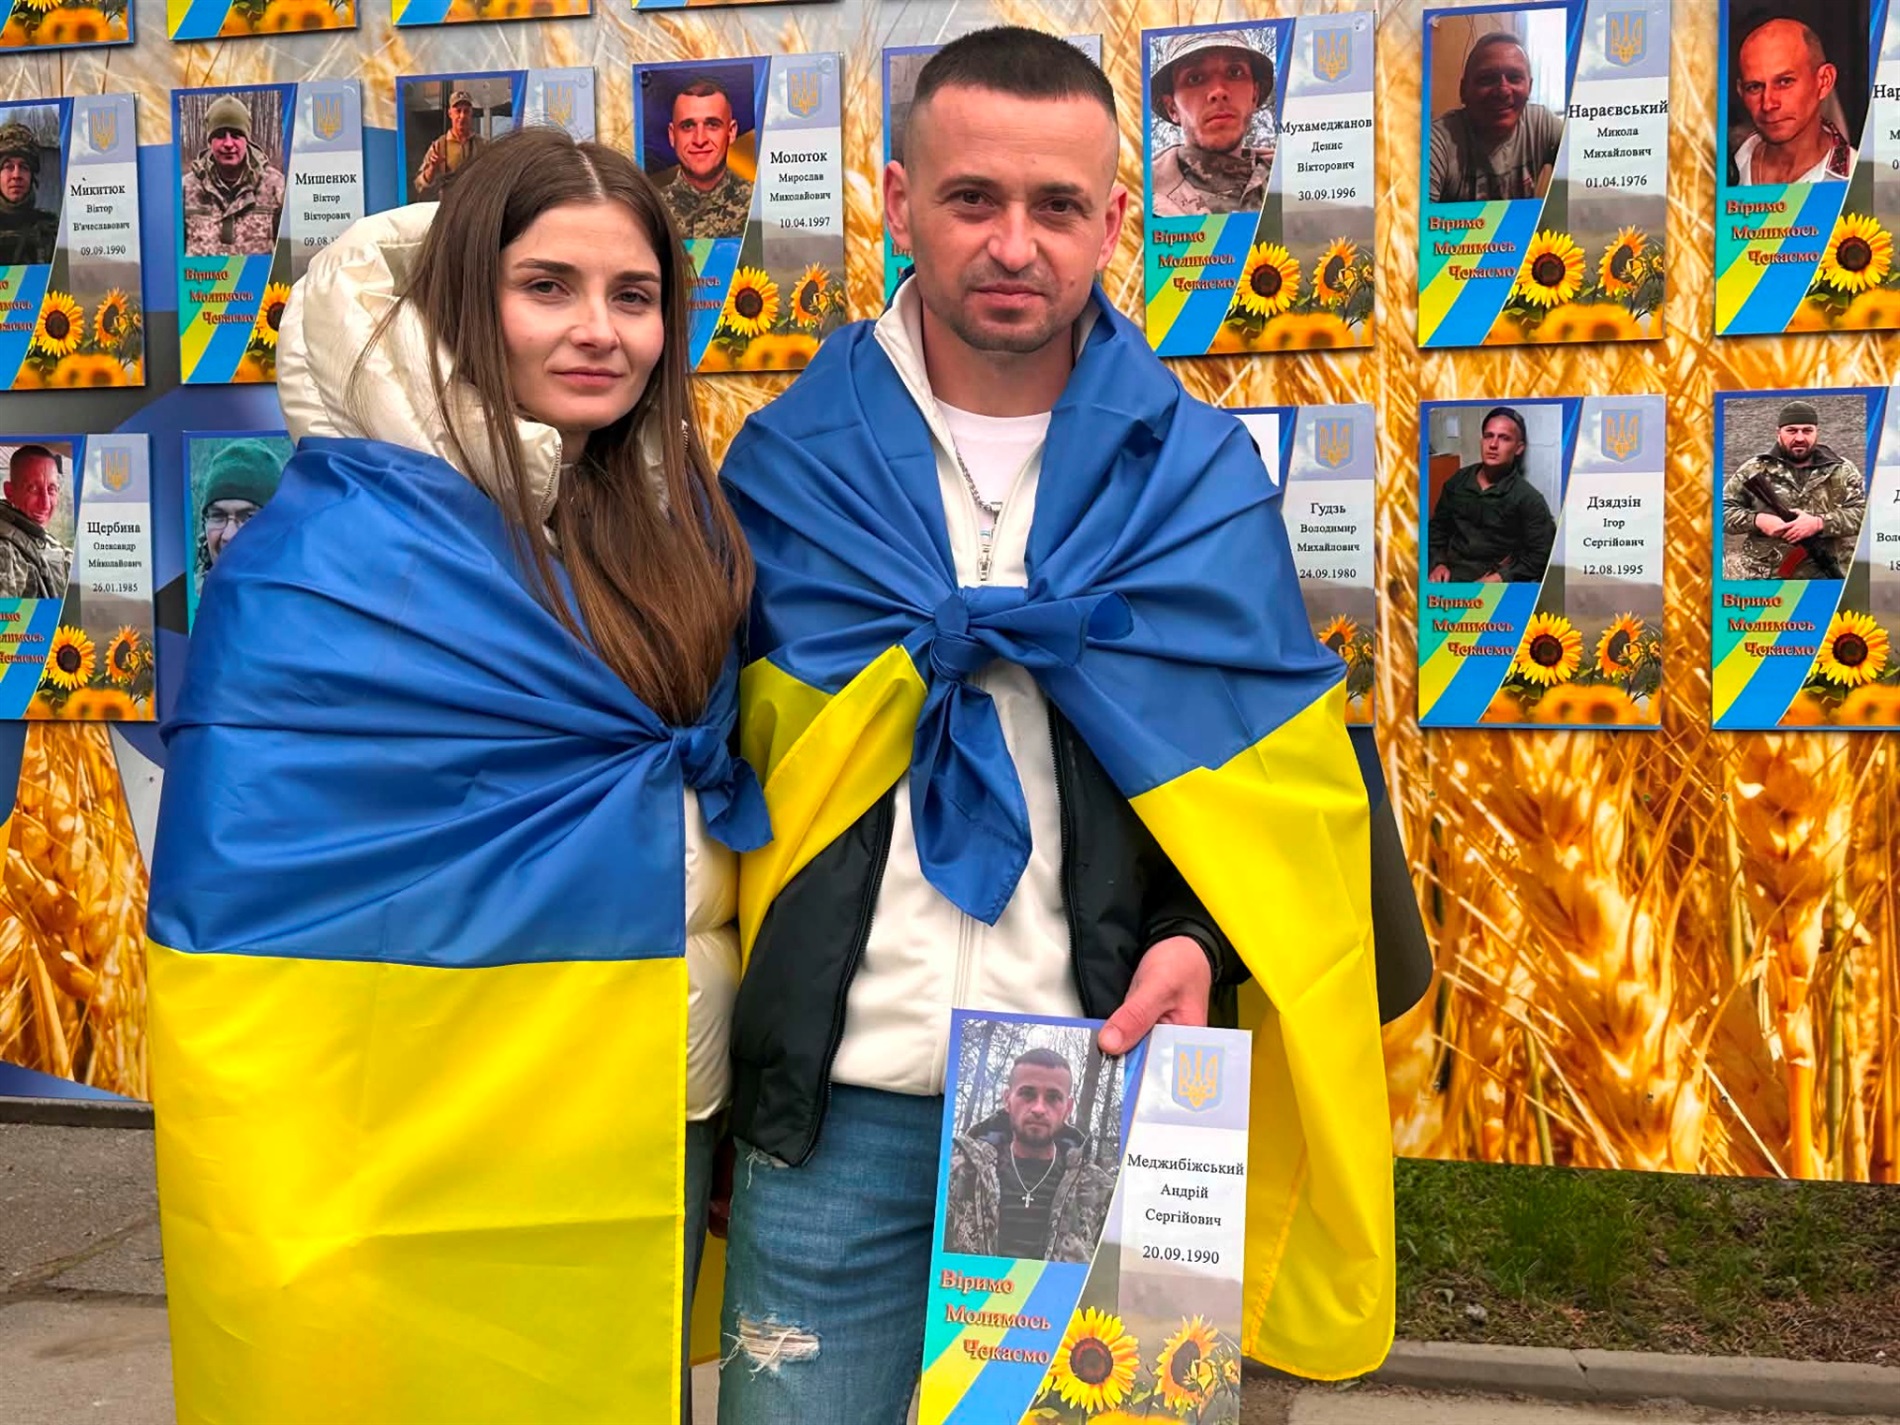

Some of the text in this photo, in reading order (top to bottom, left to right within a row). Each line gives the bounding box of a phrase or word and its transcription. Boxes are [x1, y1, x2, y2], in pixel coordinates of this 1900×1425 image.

[1568, 100, 1669, 120] Нараєвський
[1279, 118, 1373, 135] Мухамеджанов
[1597, 127, 1639, 138] Микола
[1311, 141, 1343, 153] Денис
[1583, 147, 1652, 159] Михайлович
[770, 151, 828, 164] Молоток
[1297, 161, 1355, 173] Вікторович
[295, 172, 357, 185] Мишенюк
[779, 173, 824, 184] Мирослав
[1585, 175, 1648, 189] 01.04.1976
[70, 184, 126, 196] Микитюк
[770, 191, 831, 202] Миколайович
[1298, 187, 1356, 201] 30.09.1996
[313, 194, 341, 204] Віктор
[86, 204, 113, 214] Віктор
[1726, 200, 1788, 216] Віримо
[304, 212, 351, 222] Вікторович
[780, 217, 830, 229] 10.04.1997
[1428, 216, 1486, 233] Віримо
[1153, 230, 1206, 245] Віримо
[1731, 225, 1819, 240] Молимось
[80, 246, 126, 256] 09.09.1990
[1434, 241, 1516, 256] Молимось
[1158, 253, 1235, 269] Молимось
[1748, 249, 1820, 266] Чекаємо
[1448, 266, 1516, 281] Чекаємо
[1173, 277, 1236, 292] Чекаємо
[1310, 502, 1347, 516] Гудзь
[1587, 495, 1642, 510] Дзядзін
[87, 521, 141, 536] Щербина
[1300, 523, 1358, 534] Володимир
[1603, 518, 1626, 530] Ігор
[93, 542, 136, 552] Олександр
[1297, 543, 1361, 552] Михайлович
[1583, 537, 1645, 549] Сергійович
[88, 559, 142, 568] Миколайович
[1583, 563, 1644, 576] 12.08.1995
[1299, 568, 1357, 579] 24.09.1980
[92, 583, 138, 592] 26.01.1985
[1426, 594, 1485, 611] Віримо
[1722, 593, 1784, 611] Віримо
[1432, 619, 1514, 633] Молимось
[1728, 617, 1816, 633] Молимось
[1447, 642, 1515, 657] Чекаємо
[1744, 641, 1816, 657] Чекаємо
[1126, 1153, 1245, 1177] Меджибіжський
[1160, 1184, 1209, 1201] Андрій
[1145, 1208, 1223, 1227] Сергійович
[1142, 1245, 1221, 1264] 20.09.1990
[940, 1269, 1016, 1296] Віримо
[945, 1303, 1053, 1330] Молимось
[962, 1338, 1050, 1364] Чекаємо
